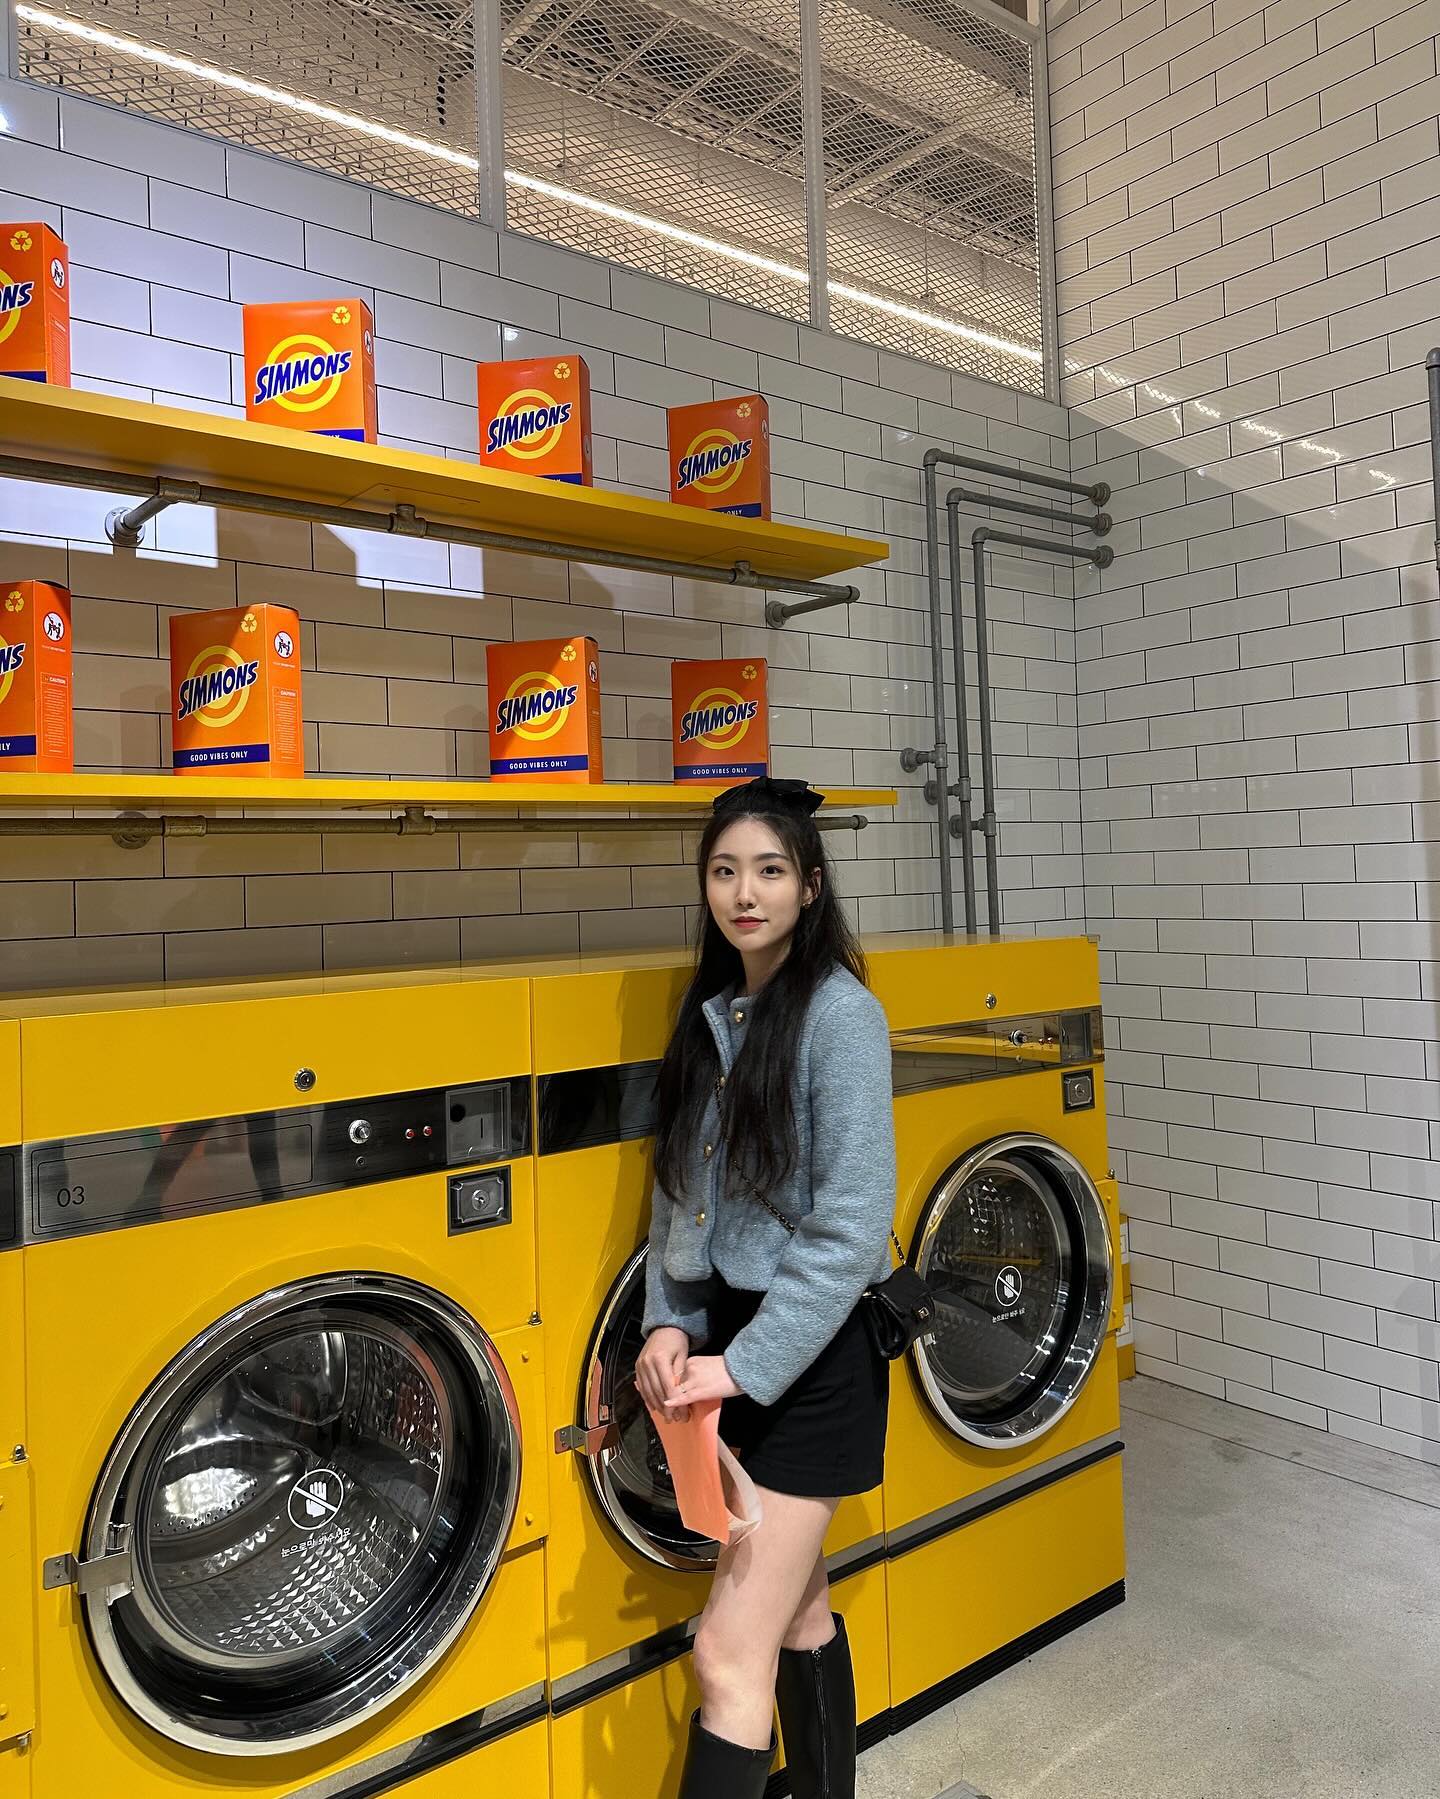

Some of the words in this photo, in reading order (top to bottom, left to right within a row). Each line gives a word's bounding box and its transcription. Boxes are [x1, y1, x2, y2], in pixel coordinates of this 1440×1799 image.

[0, 281, 35, 313] NS
[254, 351, 353, 405] SIMMONS
[486, 403, 572, 454] SIMMONS
[677, 438, 753, 490] SIMMONS
[177, 660, 260, 721] SIMMONS
[495, 684, 579, 735] SIMMONS
[679, 700, 760, 744] SIMMONS
[190, 753, 208, 762] GOOD
[210, 751, 229, 760] VIBES
[230, 750, 248, 759] ONLY
[509, 762, 528, 770] GOOD
[529, 761, 549, 769] VIBES
[550, 760, 568, 768] ONLY
[57, 1186, 85, 1208] 03
